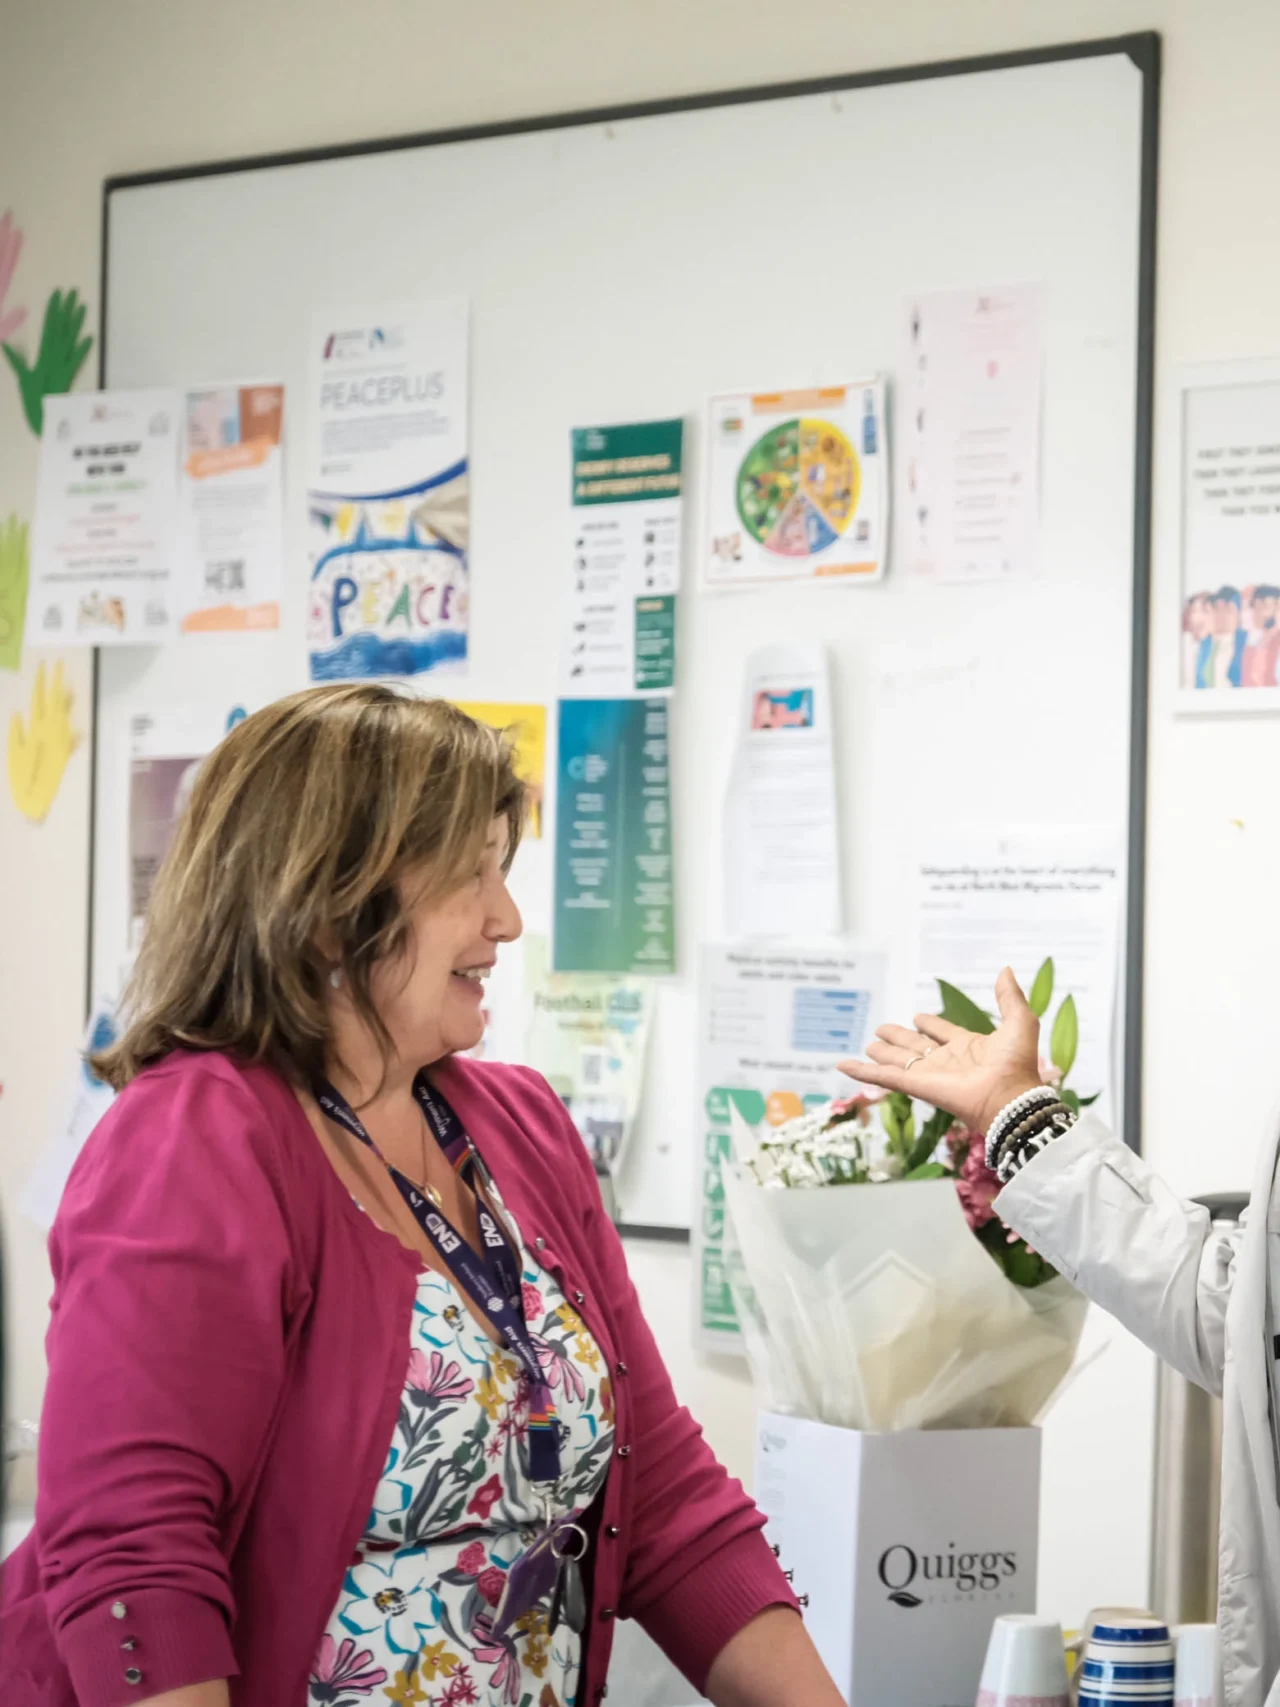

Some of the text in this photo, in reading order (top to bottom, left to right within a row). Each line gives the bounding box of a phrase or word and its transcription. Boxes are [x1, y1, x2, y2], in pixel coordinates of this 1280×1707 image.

[320, 371, 445, 410] PEACEPLUS
[331, 577, 455, 635] PEACE
[425, 1213, 461, 1253] END
[480, 1213, 504, 1247] END
[878, 1542, 1018, 1595] Quiggs
